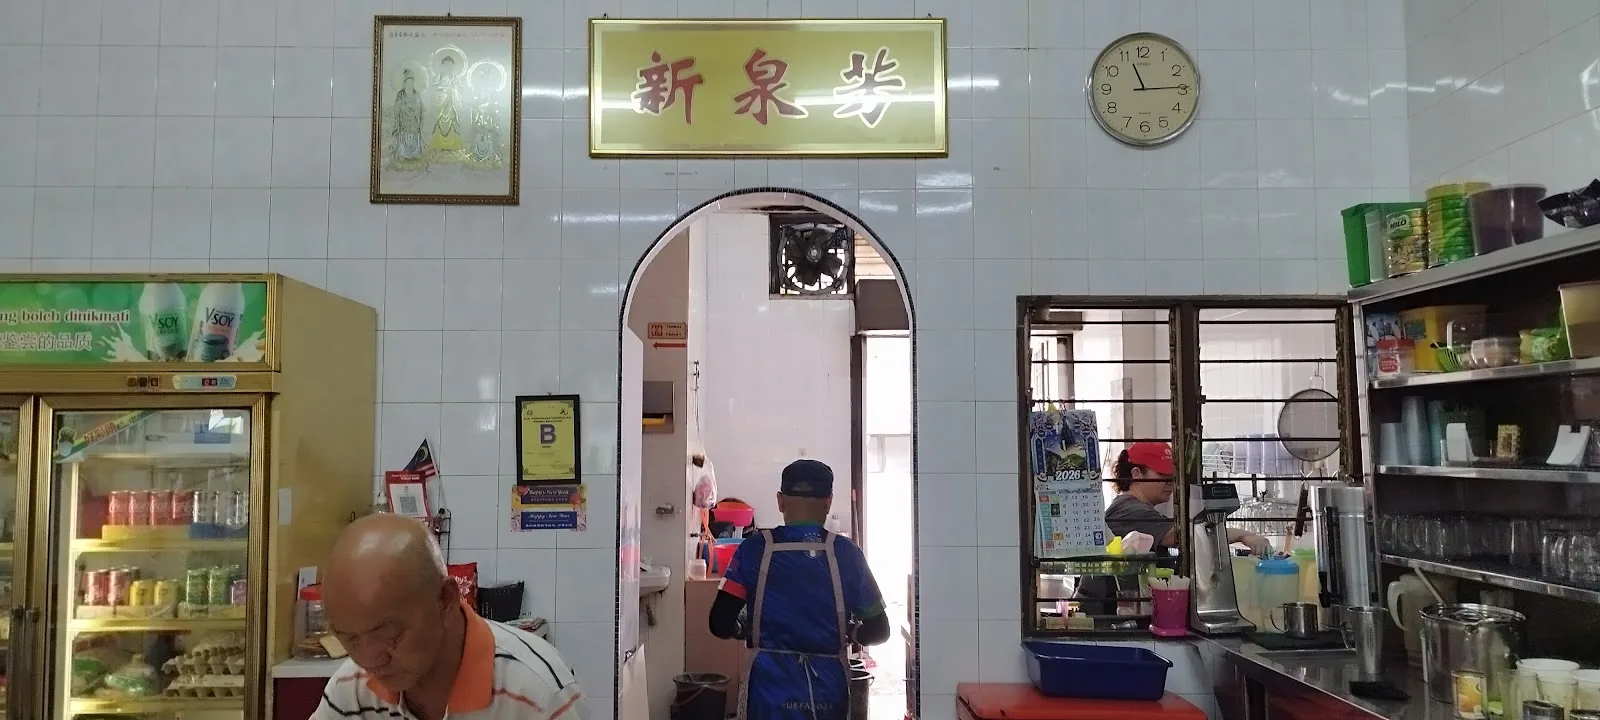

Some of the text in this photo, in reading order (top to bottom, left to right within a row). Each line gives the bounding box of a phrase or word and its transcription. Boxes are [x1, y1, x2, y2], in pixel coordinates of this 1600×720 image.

[1120, 50, 1130, 62] 11
[1136, 46, 1150, 59] 12
[1160, 50, 1165, 62] 1
[1105, 65, 1119, 77] 10
[1171, 64, 1182, 77] 2
[1101, 83, 1112, 95] 9
[1177, 83, 1188, 96] 3
[1107, 101, 1117, 114] 8
[1171, 101, 1182, 114] 4
[1122, 116, 1132, 128] 7
[1140, 120, 1151, 133] 6
[1158, 116, 1169, 128] 5
[1390, 219, 1407, 229] MILO
[22, 310, 60, 322] boleh
[65, 309, 130, 322] dinikmati
[540, 424, 557, 444] B
[1056, 469, 1081, 481] 2026
